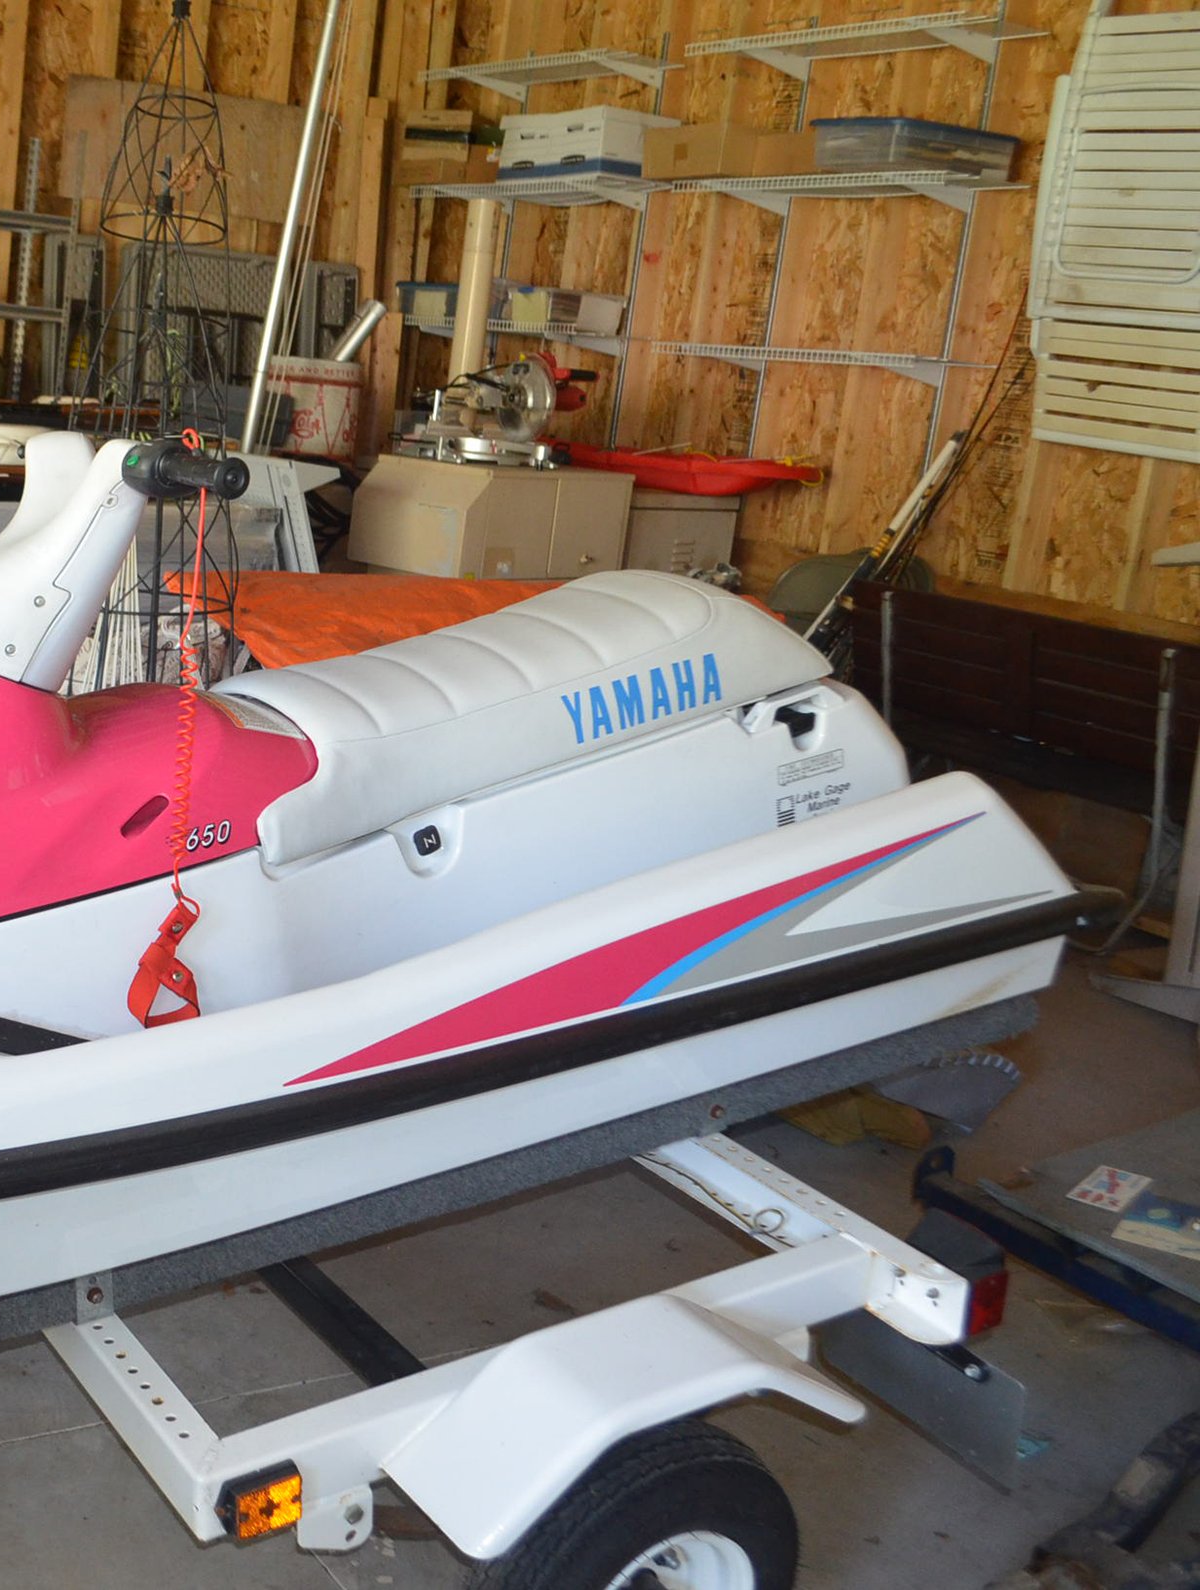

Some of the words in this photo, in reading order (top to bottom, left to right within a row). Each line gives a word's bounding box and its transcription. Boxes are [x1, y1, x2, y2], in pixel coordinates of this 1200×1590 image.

[561, 653, 722, 744] YAMAHA
[796, 790, 821, 804] Lake
[824, 782, 851, 796] Gage
[808, 797, 841, 812] Marine
[186, 819, 231, 852] 650
